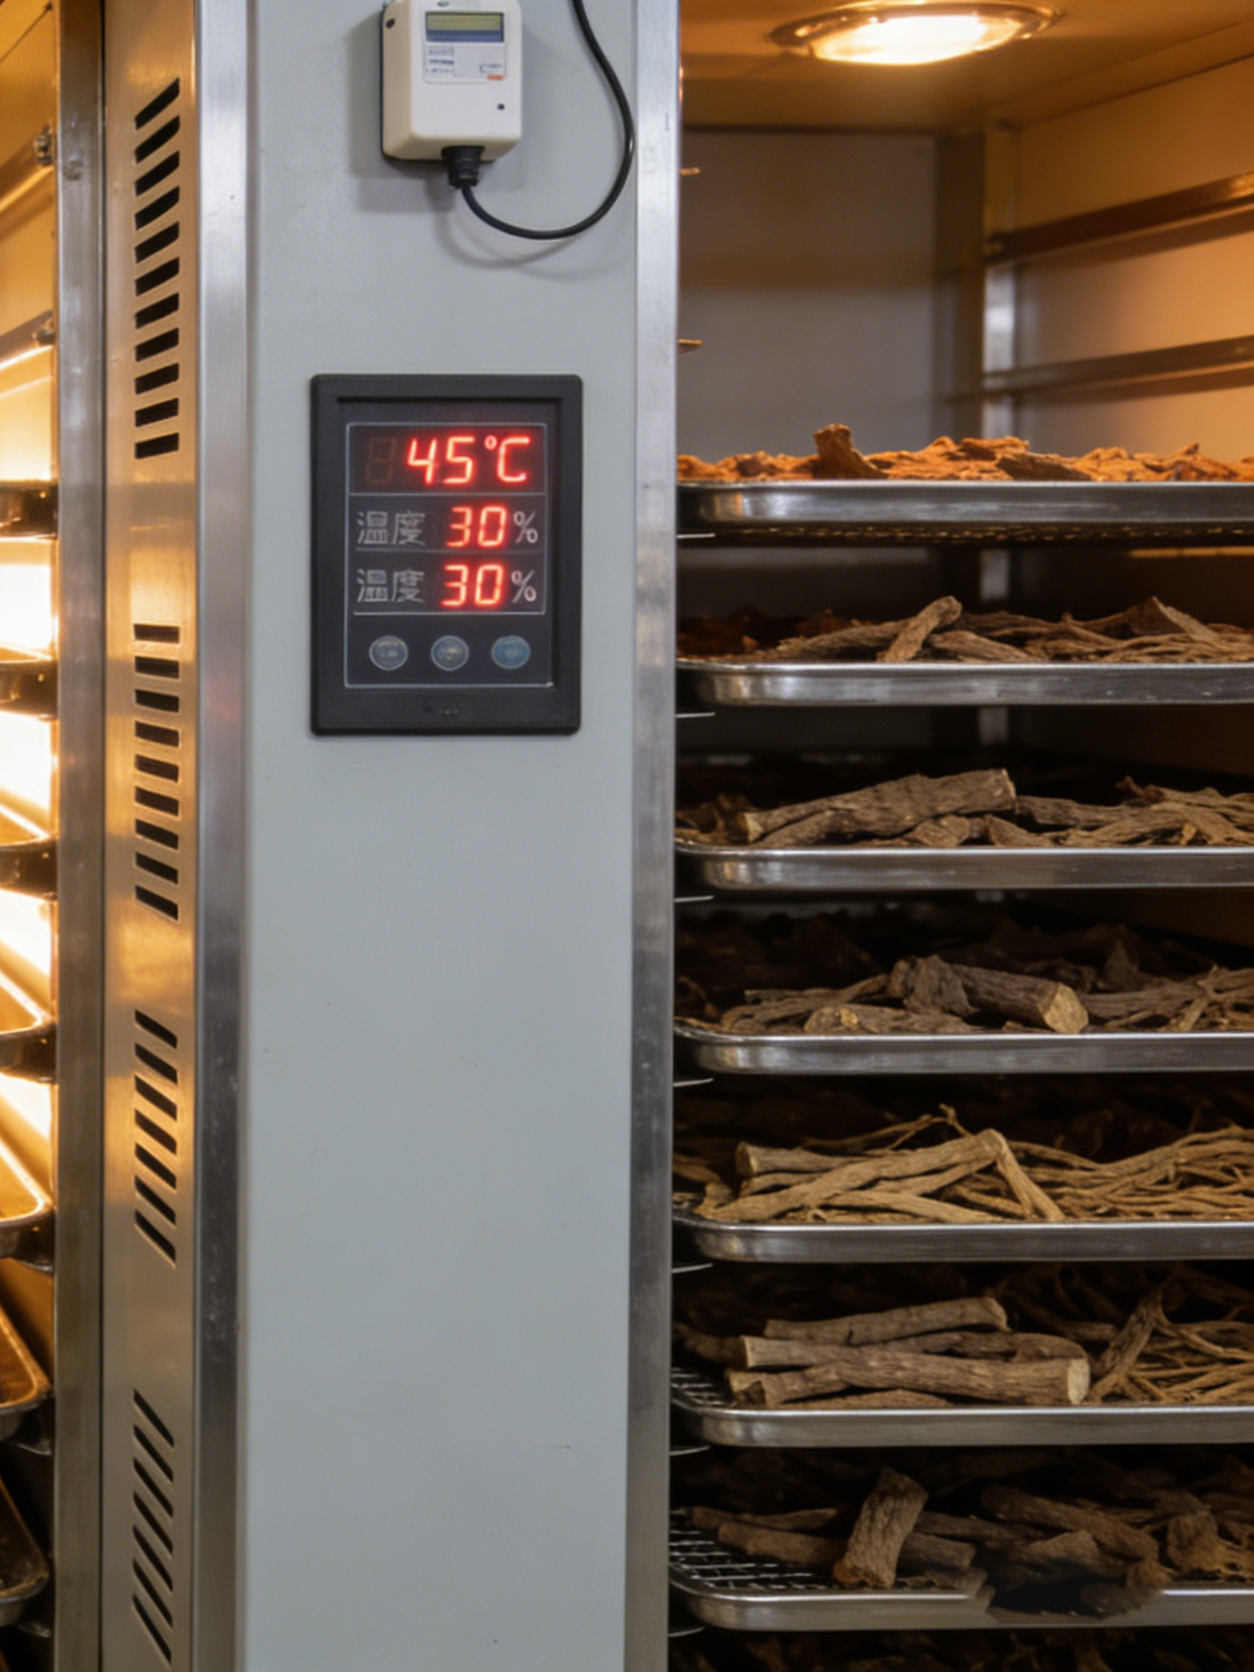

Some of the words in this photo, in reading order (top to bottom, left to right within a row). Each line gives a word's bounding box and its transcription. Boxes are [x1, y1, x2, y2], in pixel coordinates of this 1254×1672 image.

[407, 434, 530, 485] 45°C
[446, 506, 539, 547] 30%
[442, 564, 537, 607] 30%
